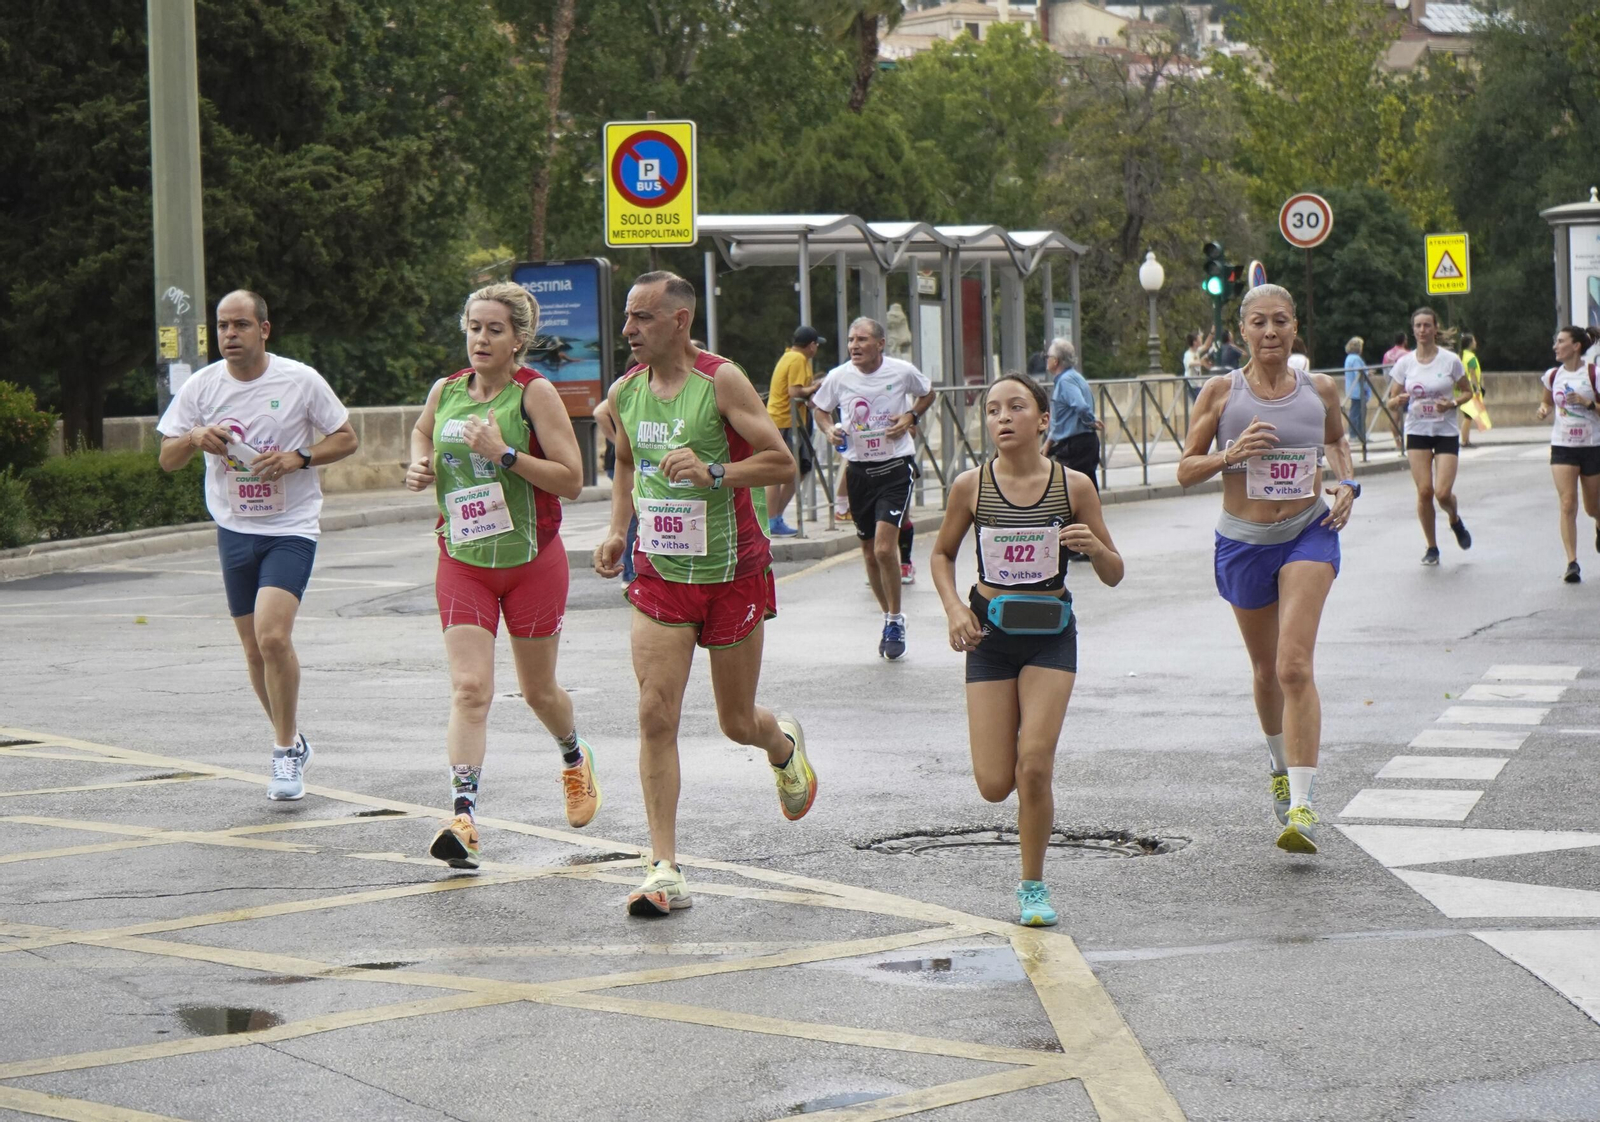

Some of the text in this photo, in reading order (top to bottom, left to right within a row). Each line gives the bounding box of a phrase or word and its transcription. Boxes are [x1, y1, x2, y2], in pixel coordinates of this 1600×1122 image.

[644, 163, 655, 176] P
[636, 181, 662, 191] BUS
[620, 213, 680, 225] SOLO BUS
[1292, 212, 1320, 229] 30
[612, 228, 690, 239] METROPOLITANO
[866, 439, 880, 449] 767
[1270, 463, 1298, 479] 507
[238, 483, 272, 499] 8025
[1275, 485, 1302, 495] vithas
[461, 500, 487, 520] 863
[470, 522, 496, 534] vithas
[653, 515, 684, 533] 865
[660, 540, 690, 550] vithas
[1003, 544, 1036, 563] 422
[1011, 571, 1042, 579] vithas
